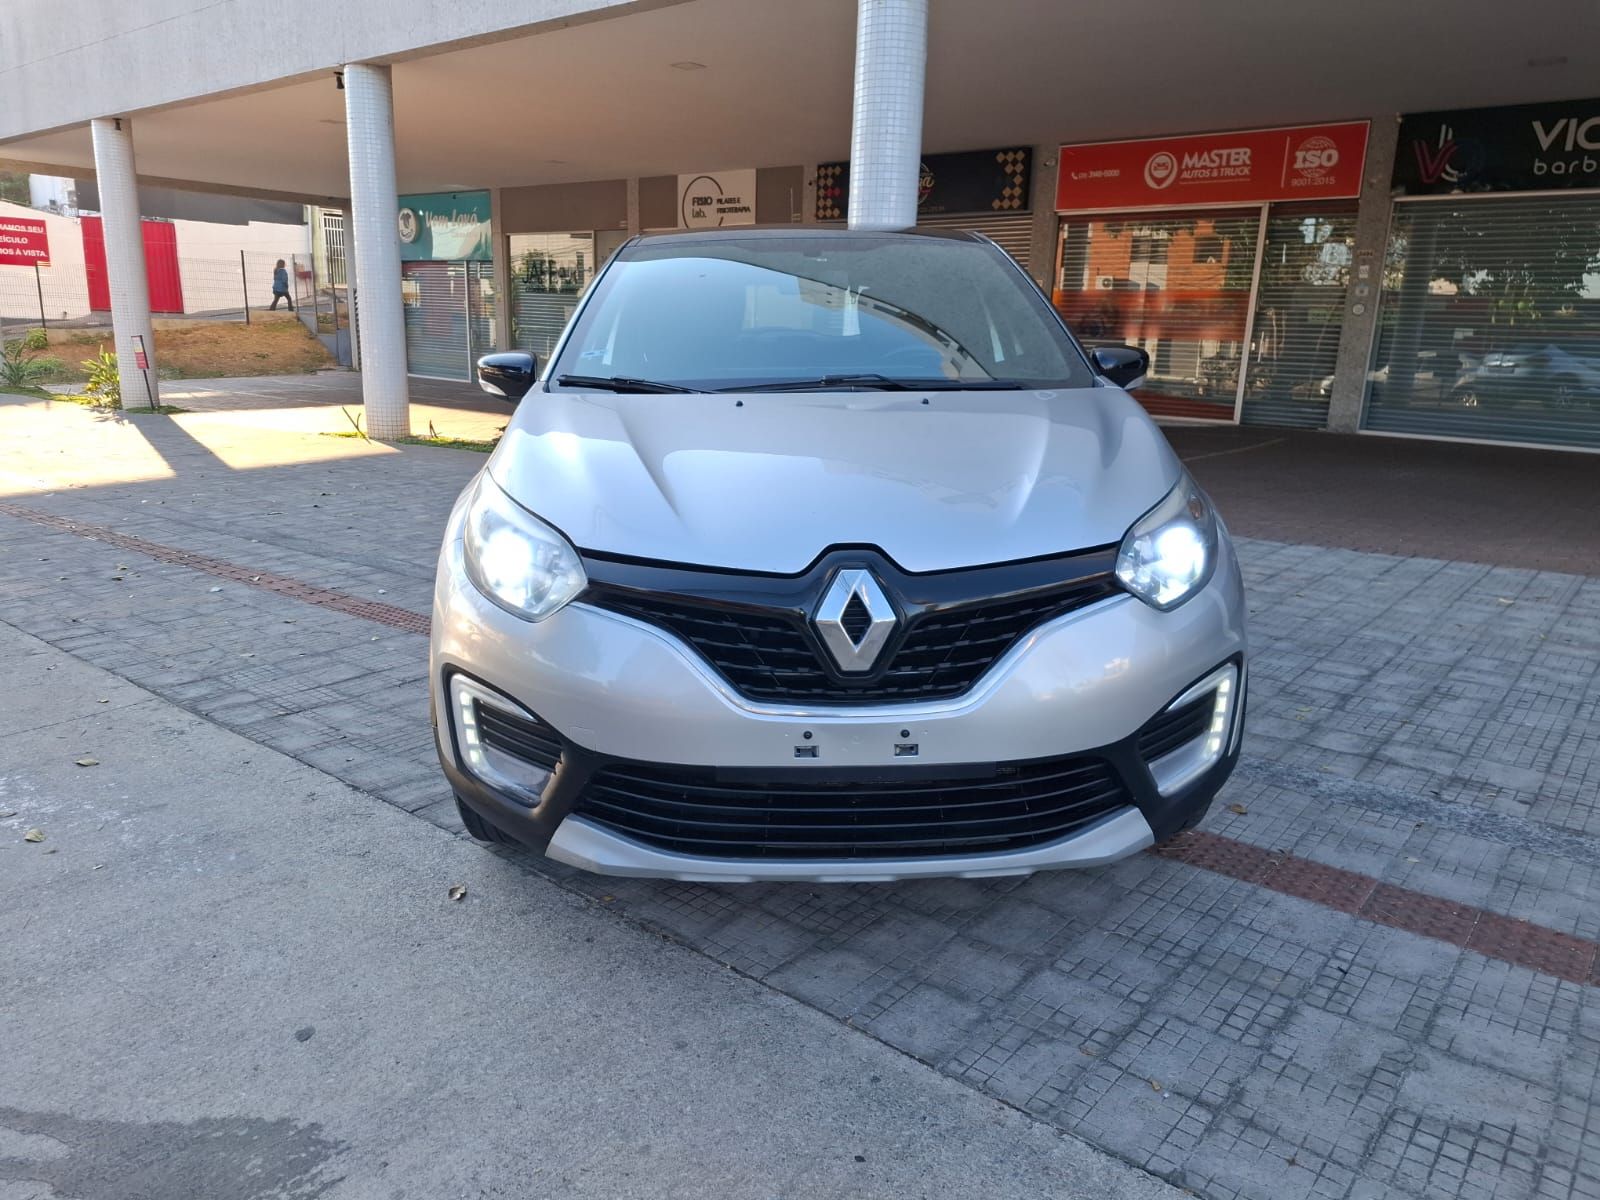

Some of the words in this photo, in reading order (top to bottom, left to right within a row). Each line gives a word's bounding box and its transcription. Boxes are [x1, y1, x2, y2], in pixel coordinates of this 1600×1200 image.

[1181, 147, 1251, 169] MASTER
[1293, 148, 1339, 169] ISO
[1180, 168, 1211, 179] AUTOS
[1219, 166, 1252, 177] TRUCK
